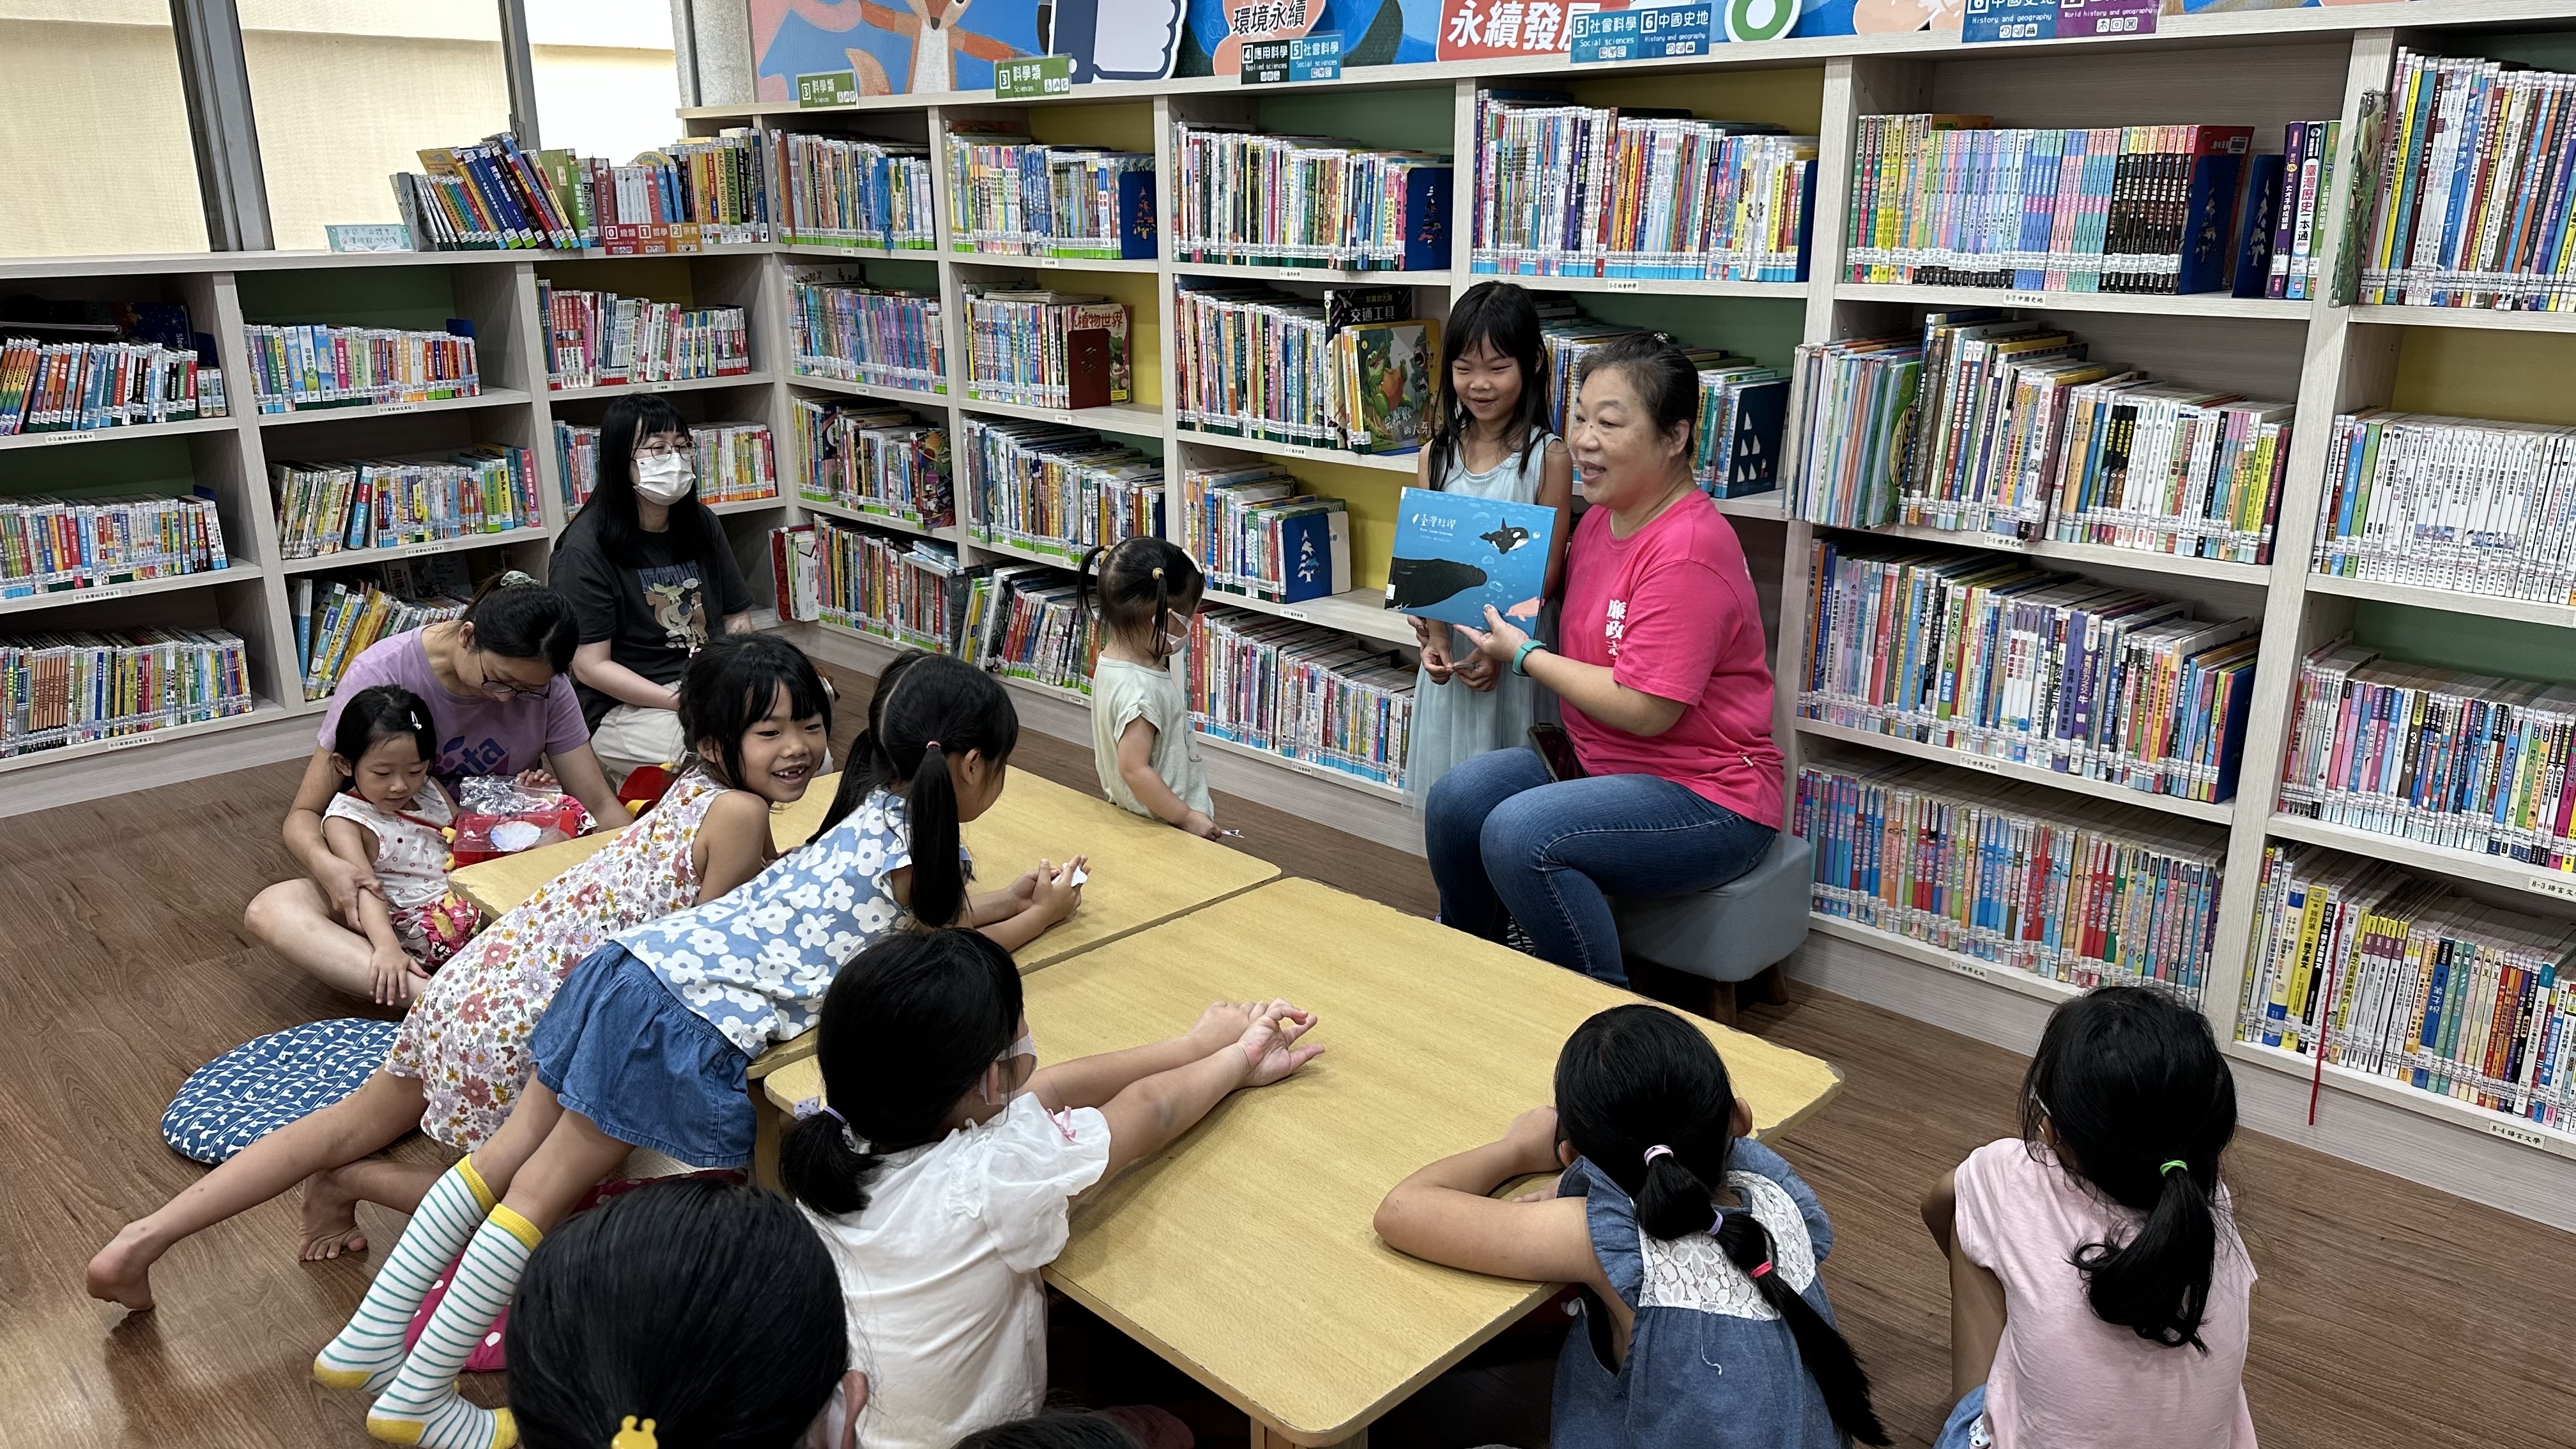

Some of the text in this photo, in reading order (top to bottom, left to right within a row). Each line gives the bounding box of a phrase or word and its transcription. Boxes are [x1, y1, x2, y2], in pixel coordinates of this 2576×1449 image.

[1233, 1, 1306, 34] 環境永續
[1659, 10, 1708, 29] 中國史地
[2016, 14, 2052, 22] geography
[1590, 17, 1637, 34] 社會科學
[1605, 37, 1634, 45] sciences
[1678, 33, 1706, 42] geography
[1254, 45, 1288, 60] 應用科學
[1303, 41, 1339, 56] 社會科學
[1013, 65, 1041, 81] 科學類
[812, 79, 834, 93] 科學類
[717, 153, 726, 185] MAGICAL
[725, 152, 738, 217] DINO EXPLORER
[2297, 165, 2317, 241] 臺灣歷史一本通
[683, 227, 698, 235] 宗教
[2018, 295, 2044, 303] 中國史地
[1078, 310, 1123, 328] 植物世界
[1350, 305, 1395, 323] 交通工具
[1404, 421, 1429, 435] 的大牙
[1605, 599, 1627, 660] 廉政志
[1972, 760, 1997, 770] 世界史地
[2531, 880, 2545, 889] 8-3
[1961, 966, 1986, 977] 世界史地
[2428, 986, 2442, 1015] 弟子規
[2492, 1125, 2541, 1144] 8-4 語言文學
